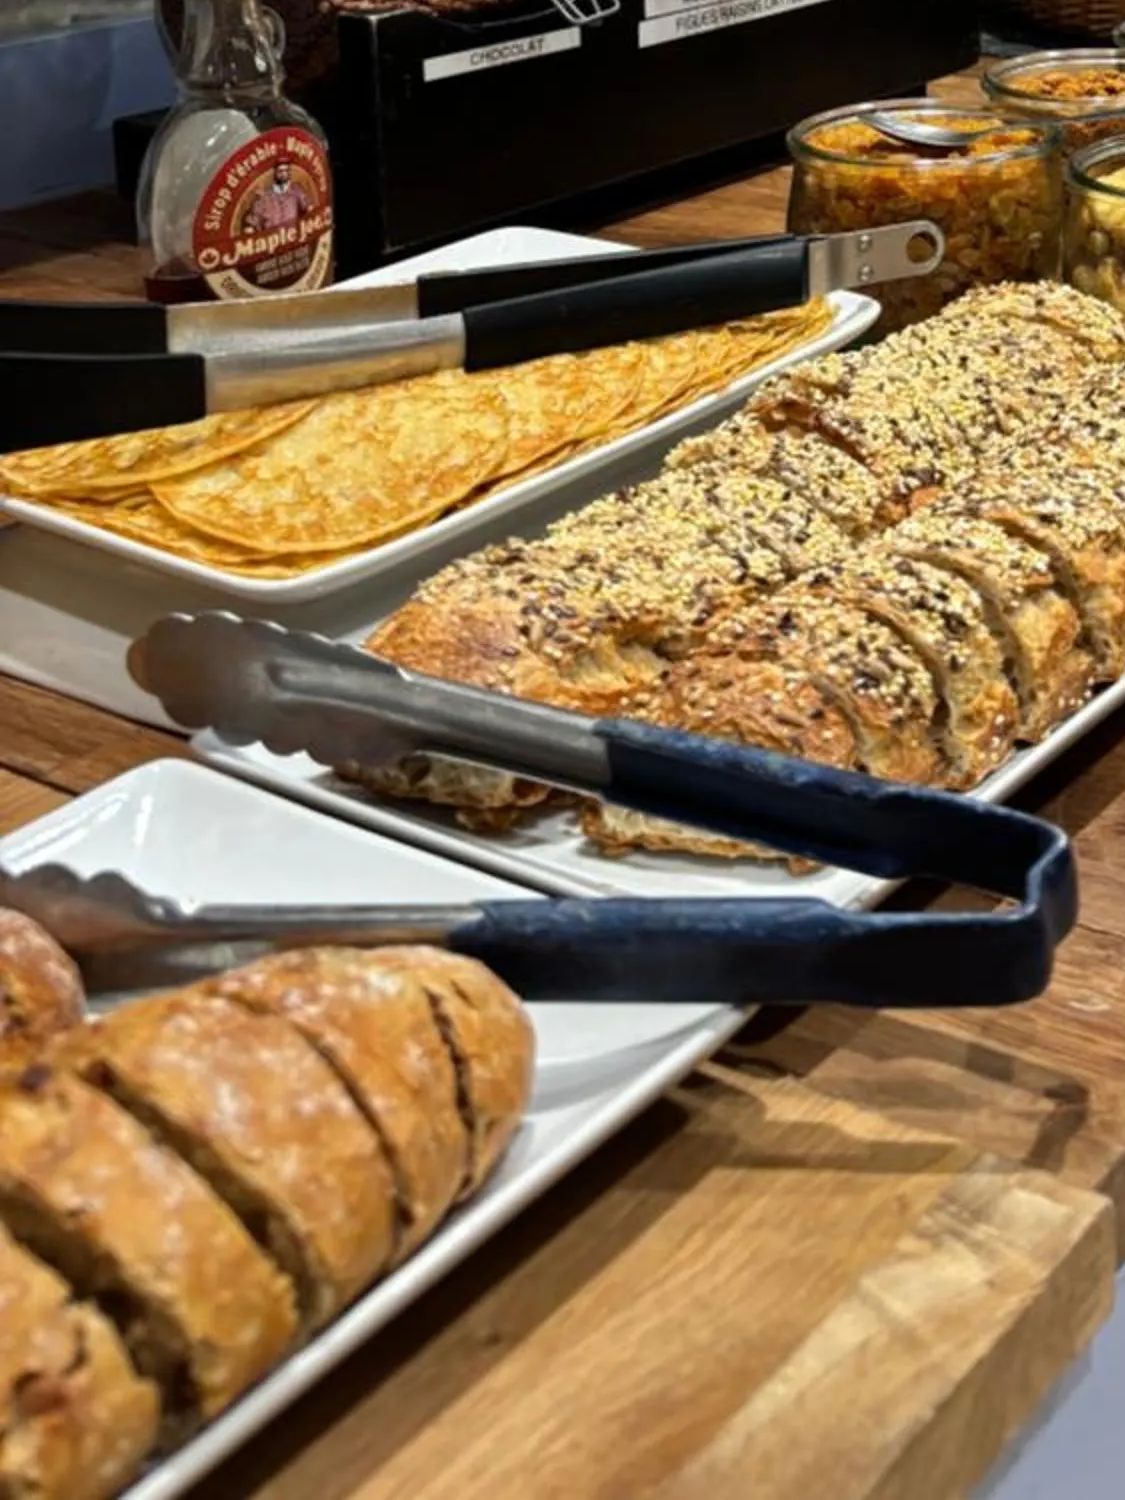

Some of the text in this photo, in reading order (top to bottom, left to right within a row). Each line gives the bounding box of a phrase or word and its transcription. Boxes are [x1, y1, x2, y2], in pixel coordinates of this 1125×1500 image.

[469, 37, 544, 66] CHOCOLAT
[204, 186, 232, 231] Sirop
[222, 227, 297, 266] Maple
